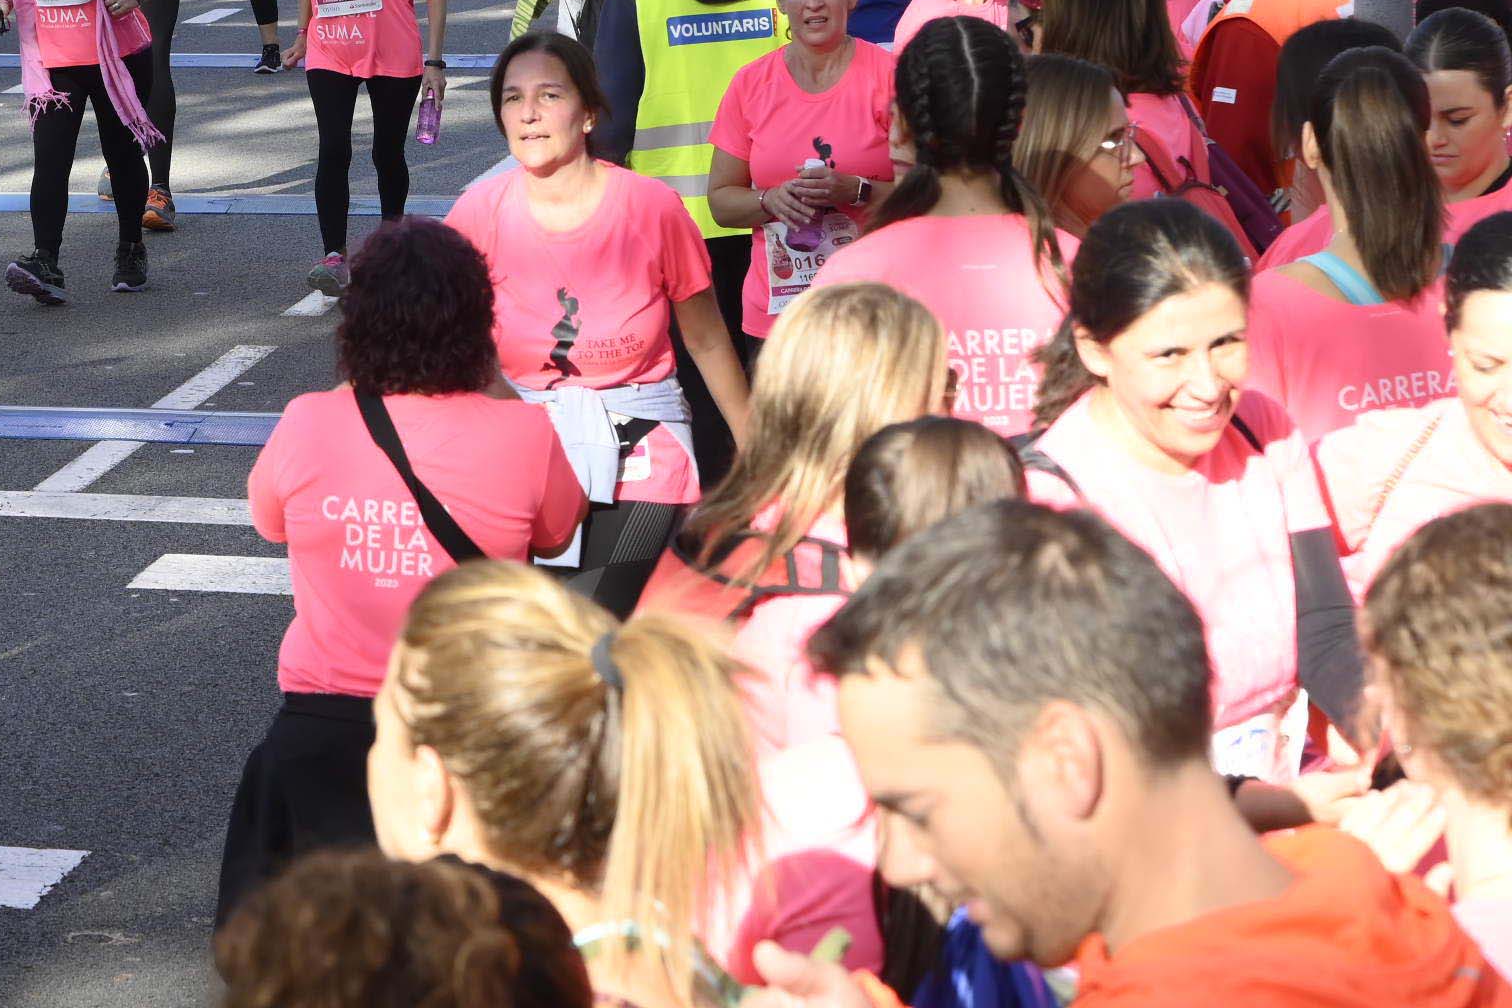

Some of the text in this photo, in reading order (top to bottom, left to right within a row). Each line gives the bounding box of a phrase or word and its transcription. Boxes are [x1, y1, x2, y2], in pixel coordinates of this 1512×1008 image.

[38, 8, 88, 23] SUMA
[316, 24, 363, 40] SUMA
[669, 14, 770, 40] VOLUNTARIS
[794, 254, 826, 270] 016
[577, 340, 645, 359] TO THE TOP
[586, 334, 636, 349] TAKE ME
[999, 357, 1036, 382] LA
[321, 495, 449, 526] CARRE
[345, 525, 429, 550] DE LA
[340, 547, 433, 577] MUJER
